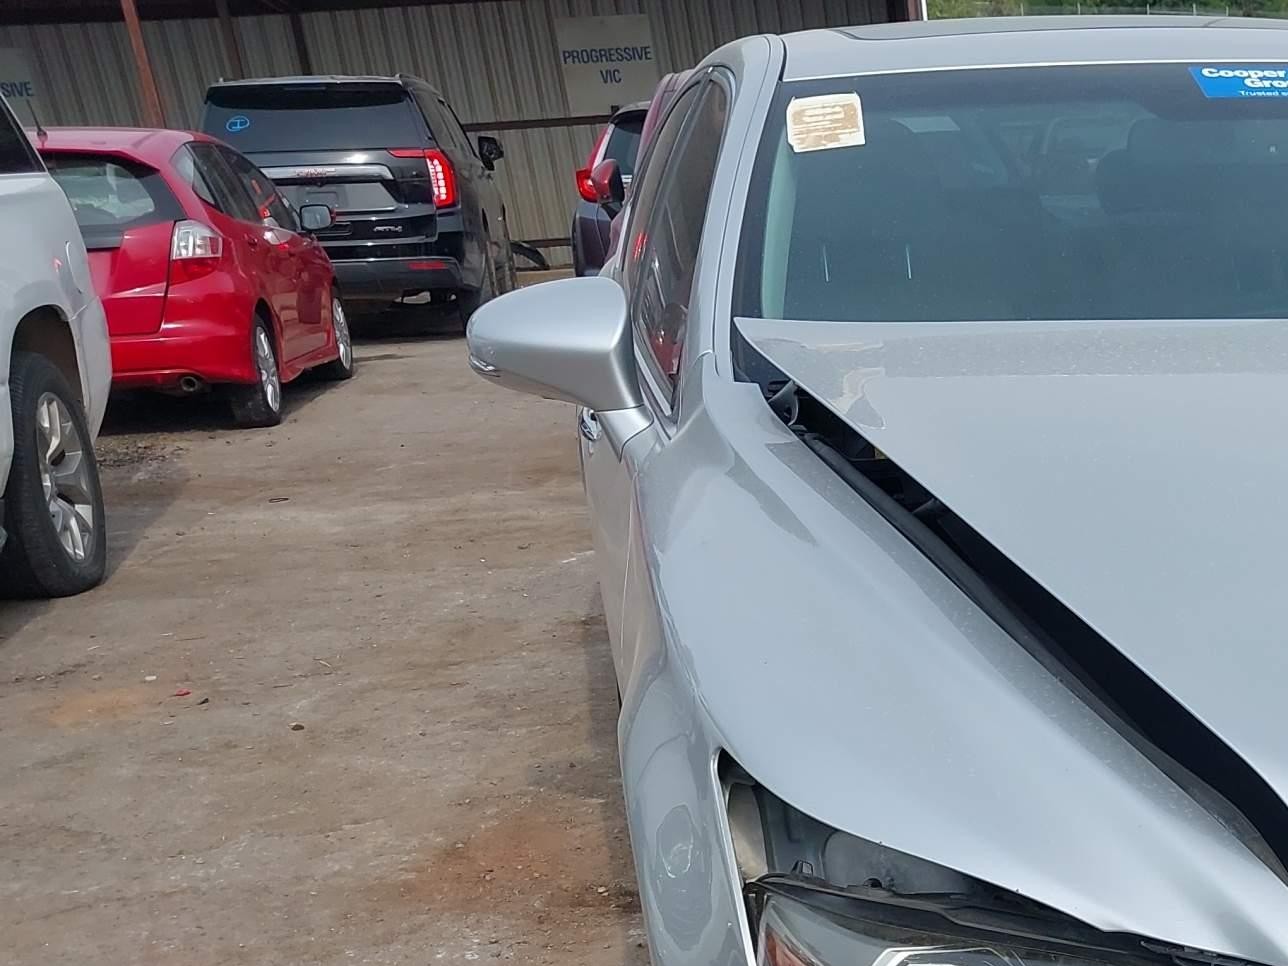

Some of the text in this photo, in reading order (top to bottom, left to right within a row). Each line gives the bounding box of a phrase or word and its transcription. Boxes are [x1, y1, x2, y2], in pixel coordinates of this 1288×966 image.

[562, 45, 653, 64] PROGRESSIVE
[600, 69, 622, 84] VIC
[1201, 68, 1287, 79] Cooper
